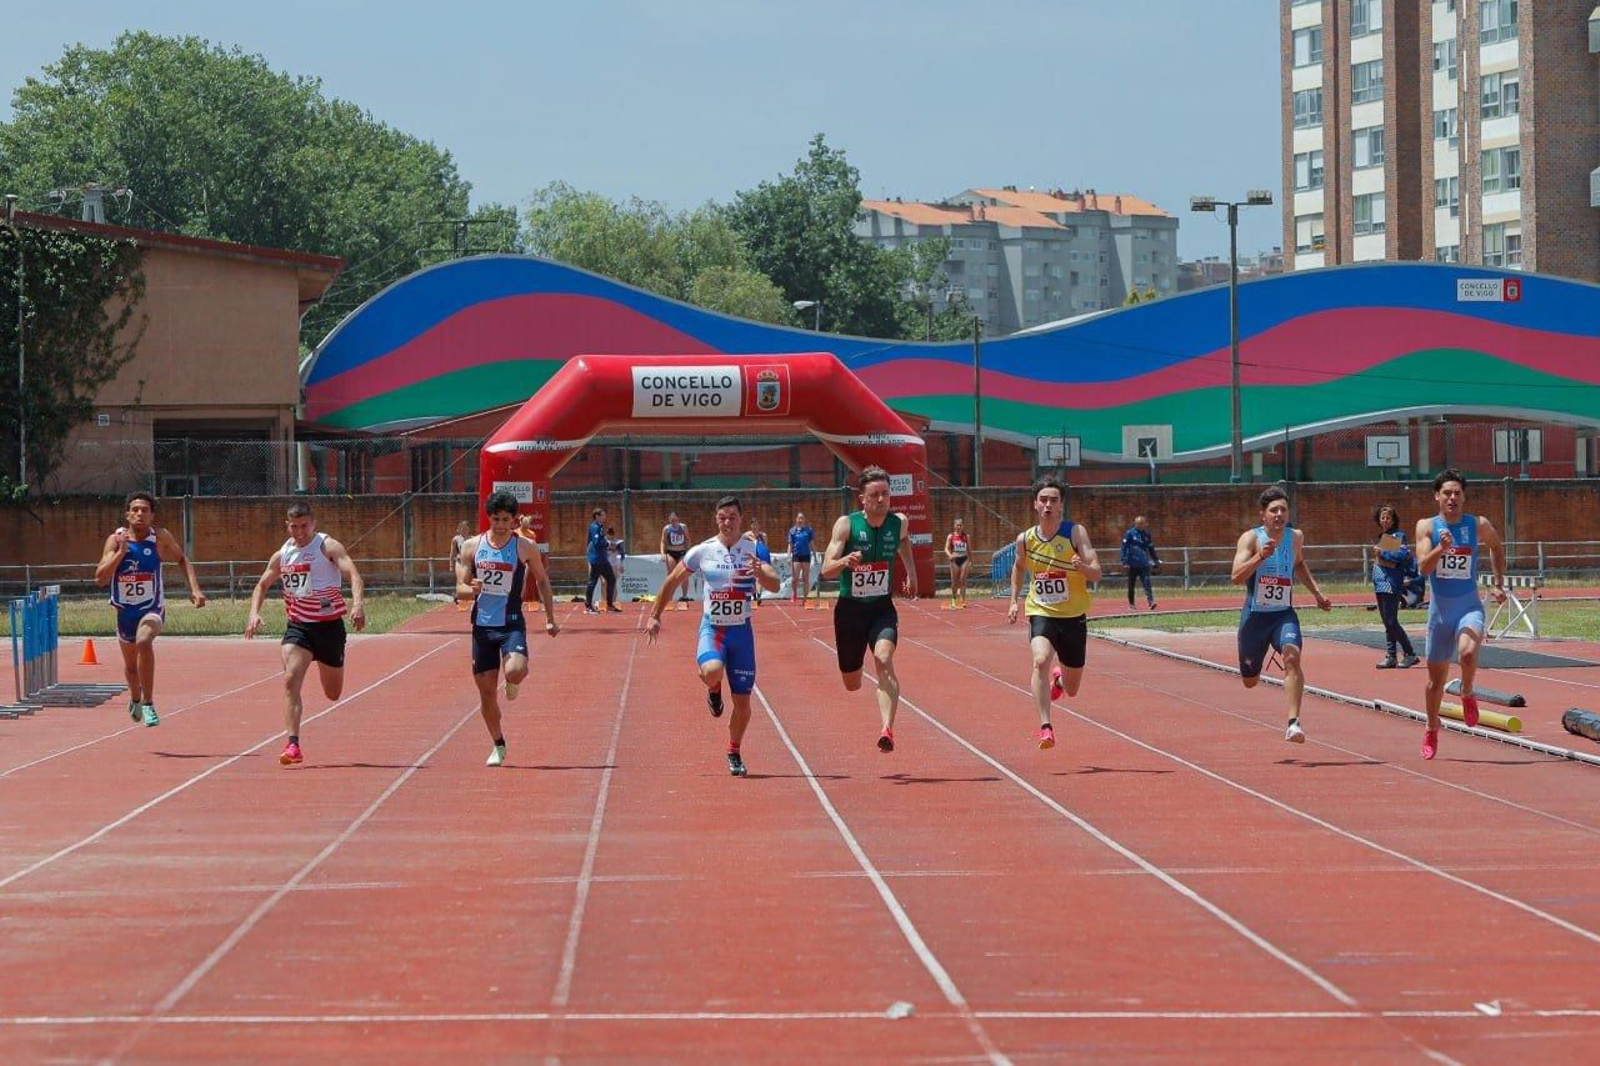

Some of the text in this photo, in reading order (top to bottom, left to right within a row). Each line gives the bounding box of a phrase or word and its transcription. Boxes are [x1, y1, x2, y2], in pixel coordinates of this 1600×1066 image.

[641, 376, 732, 390] CONCELLO
[652, 394, 722, 407] DE VIGO
[1440, 555, 1467, 570] 132
[283, 573, 307, 588] 297
[483, 570, 504, 586] 22
[854, 571, 886, 588] 347
[1260, 576, 1278, 584] VIGO
[125, 582, 146, 597] 26
[1035, 579, 1066, 595] 360
[1264, 585, 1284, 600] 33
[710, 600, 743, 616] 268
